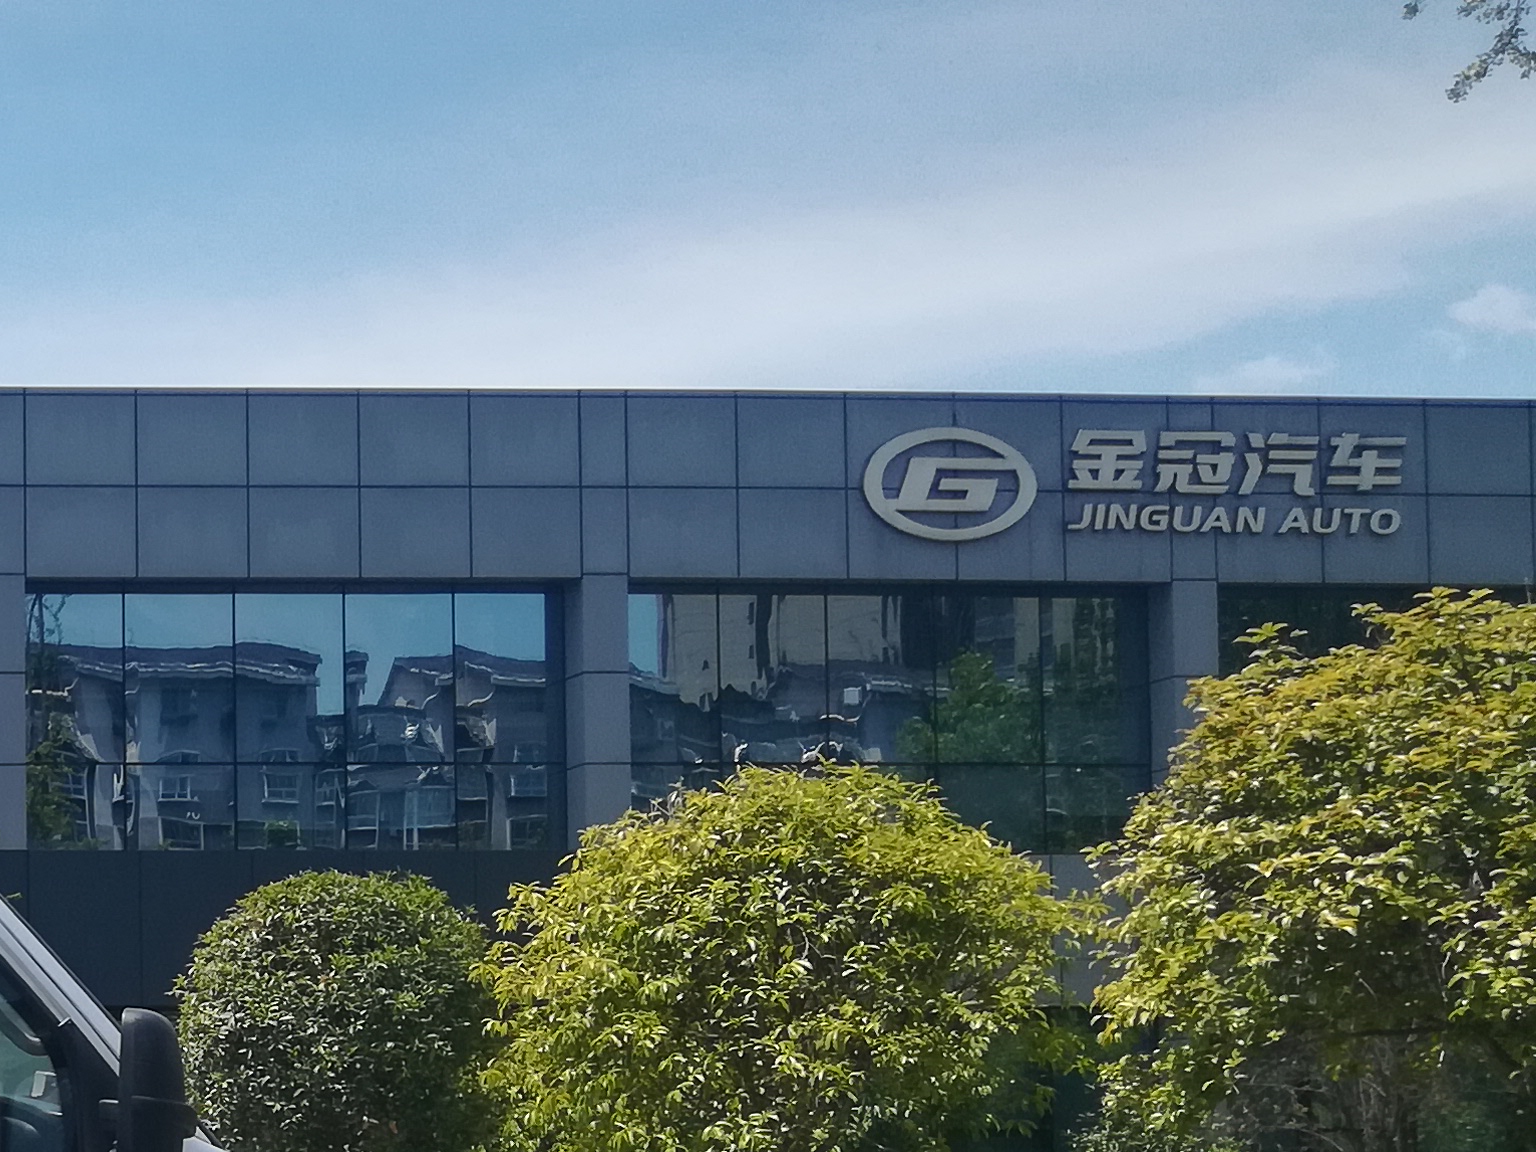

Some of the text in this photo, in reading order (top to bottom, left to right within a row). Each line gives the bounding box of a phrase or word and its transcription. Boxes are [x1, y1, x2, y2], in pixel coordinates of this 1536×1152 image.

[1067, 429, 1408, 497] 金冠汽车
[1068, 503, 1402, 535] JINGUAN AUTO
